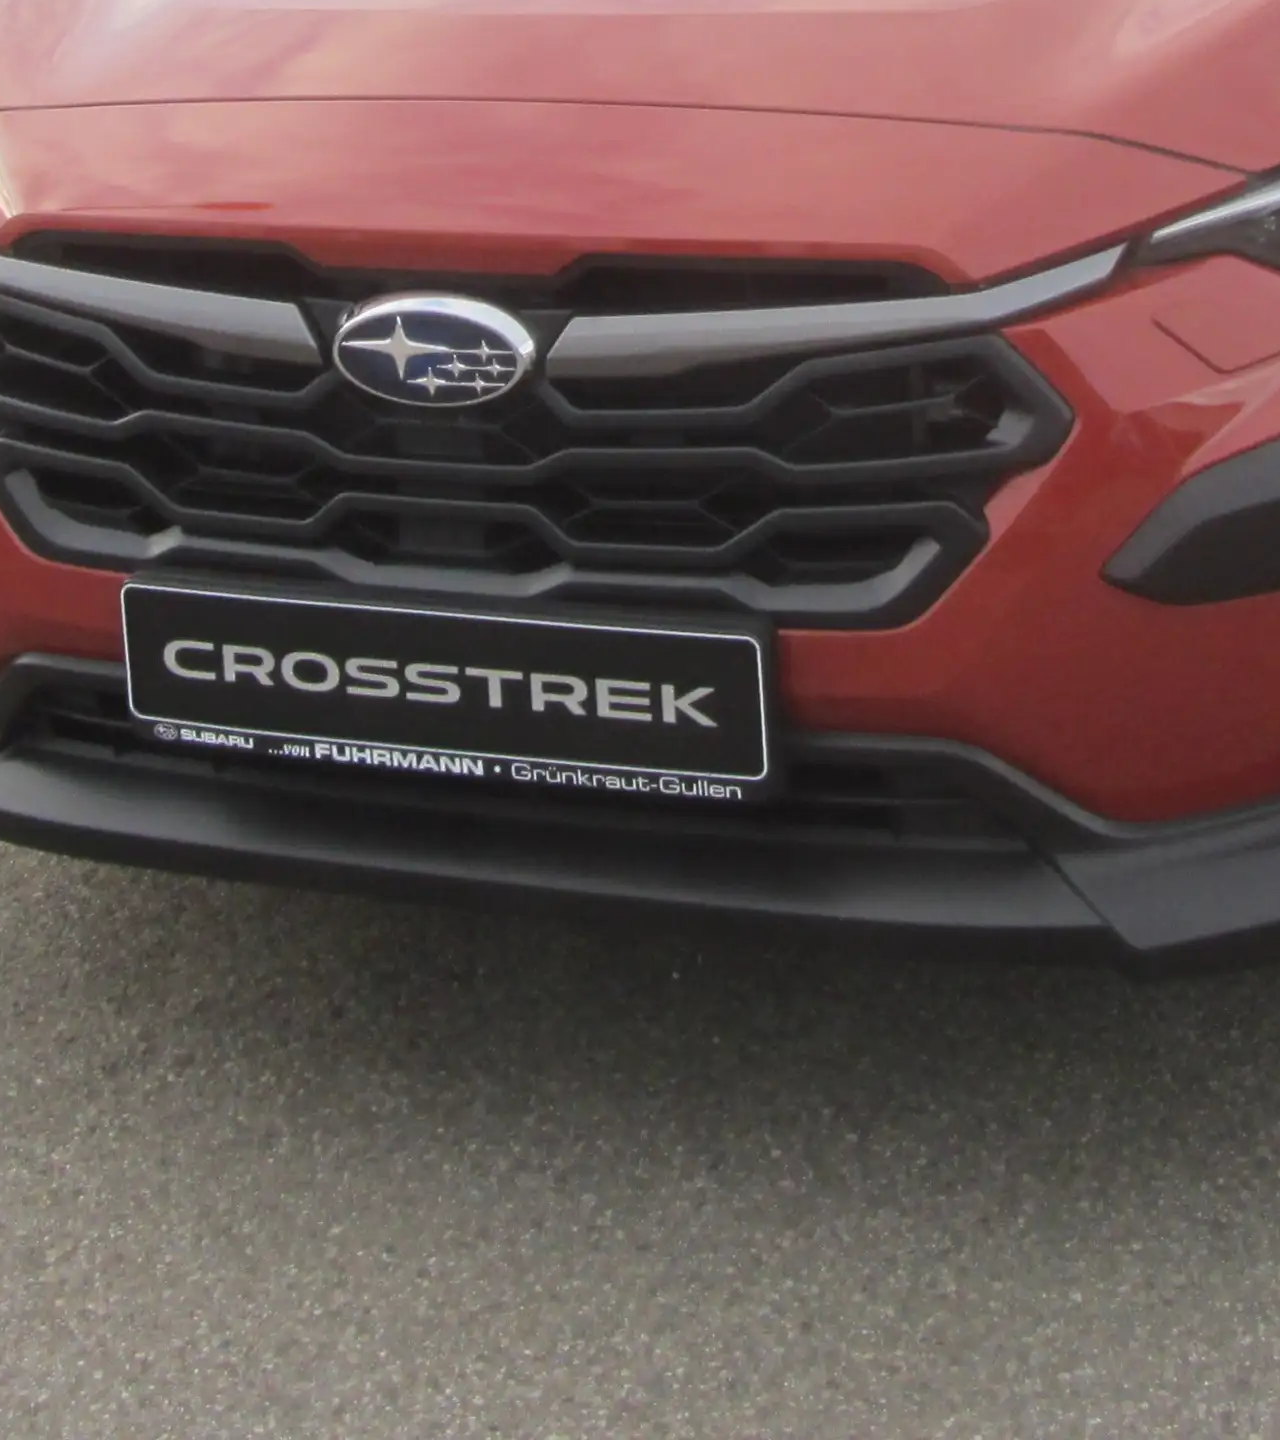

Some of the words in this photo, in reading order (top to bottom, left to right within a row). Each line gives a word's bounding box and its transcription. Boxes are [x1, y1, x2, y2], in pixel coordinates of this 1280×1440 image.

[162, 639, 719, 728] CROSSTREK
[179, 727, 254, 749] SUBARU
[314, 742, 484, 776] FUHRMANN
[510, 762, 743, 800] Grünkraut-Gullen
